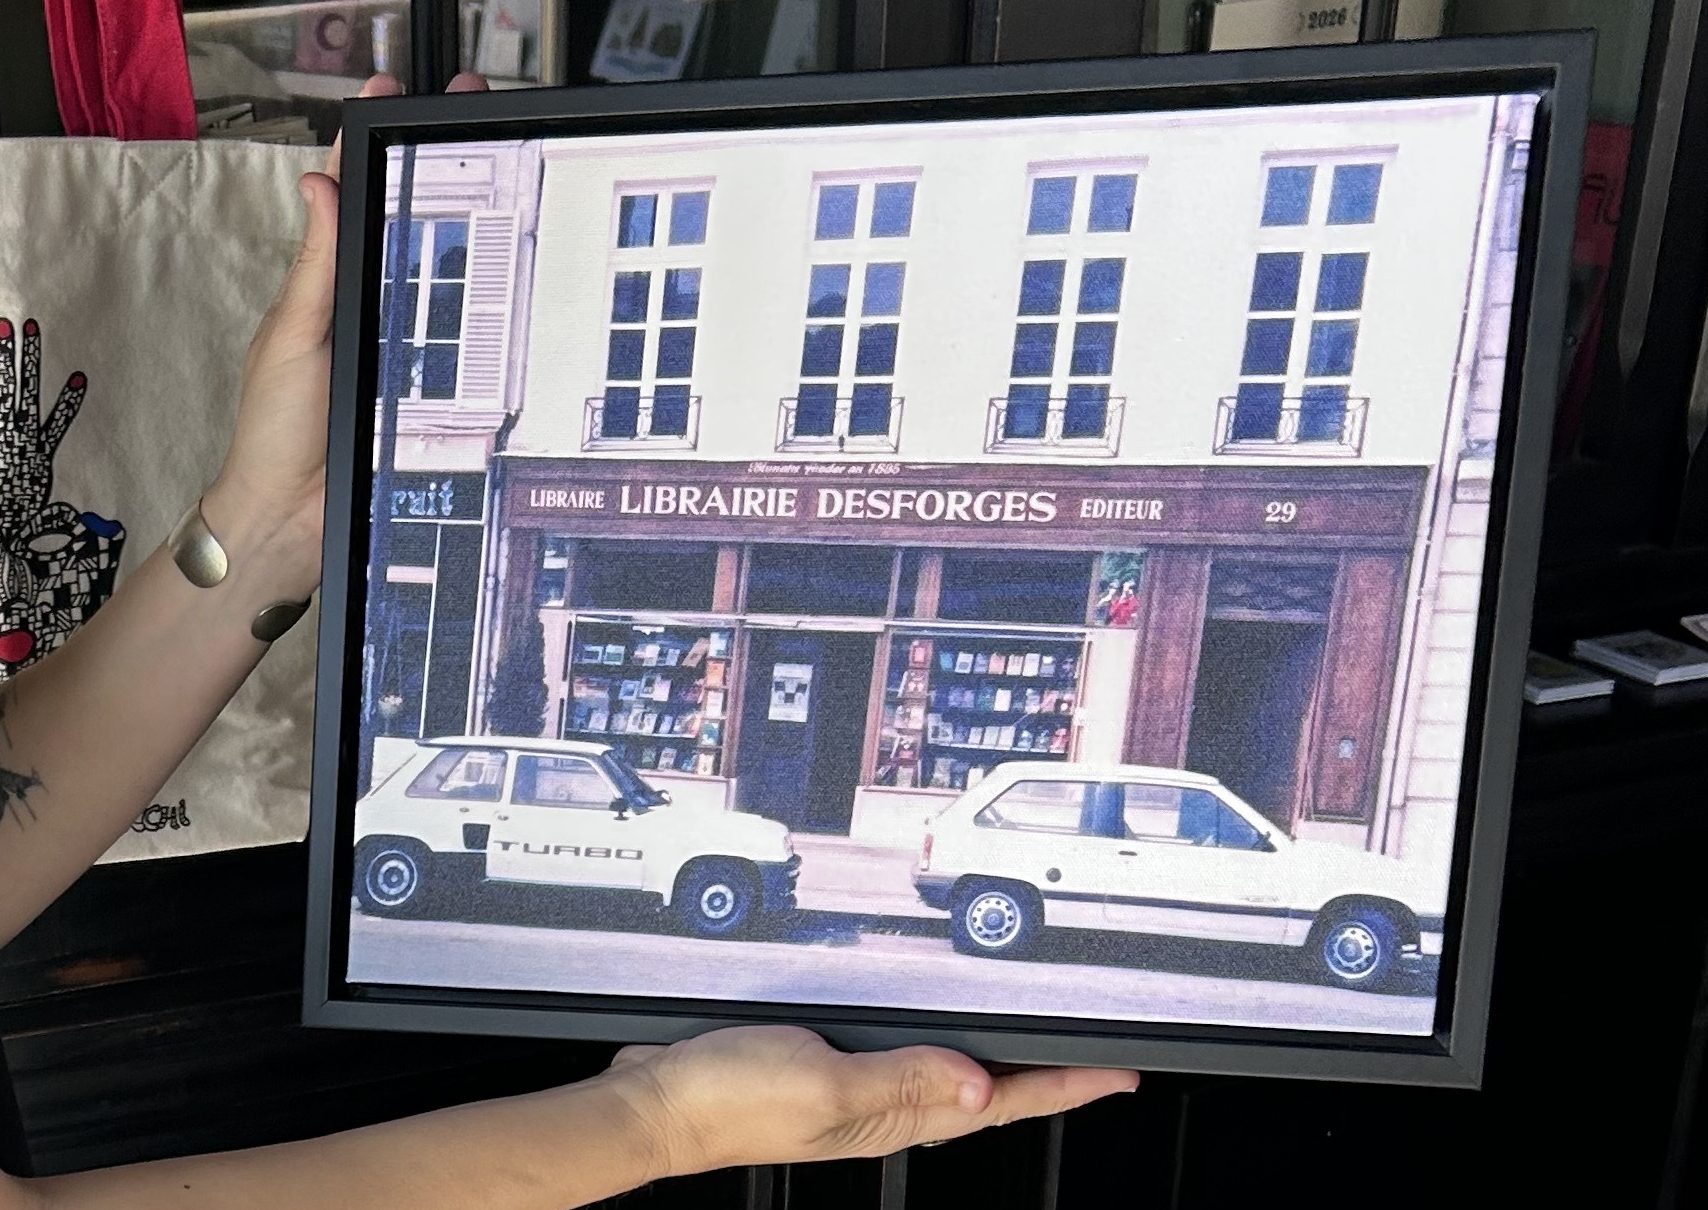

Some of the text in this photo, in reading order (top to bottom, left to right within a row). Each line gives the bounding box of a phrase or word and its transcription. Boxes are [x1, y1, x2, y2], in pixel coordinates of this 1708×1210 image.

[529, 485, 1297, 523] LIBRAIRE LIBRAIRIE DESFORGES EDITEUR 29
[493, 840, 643, 860] TURBO
